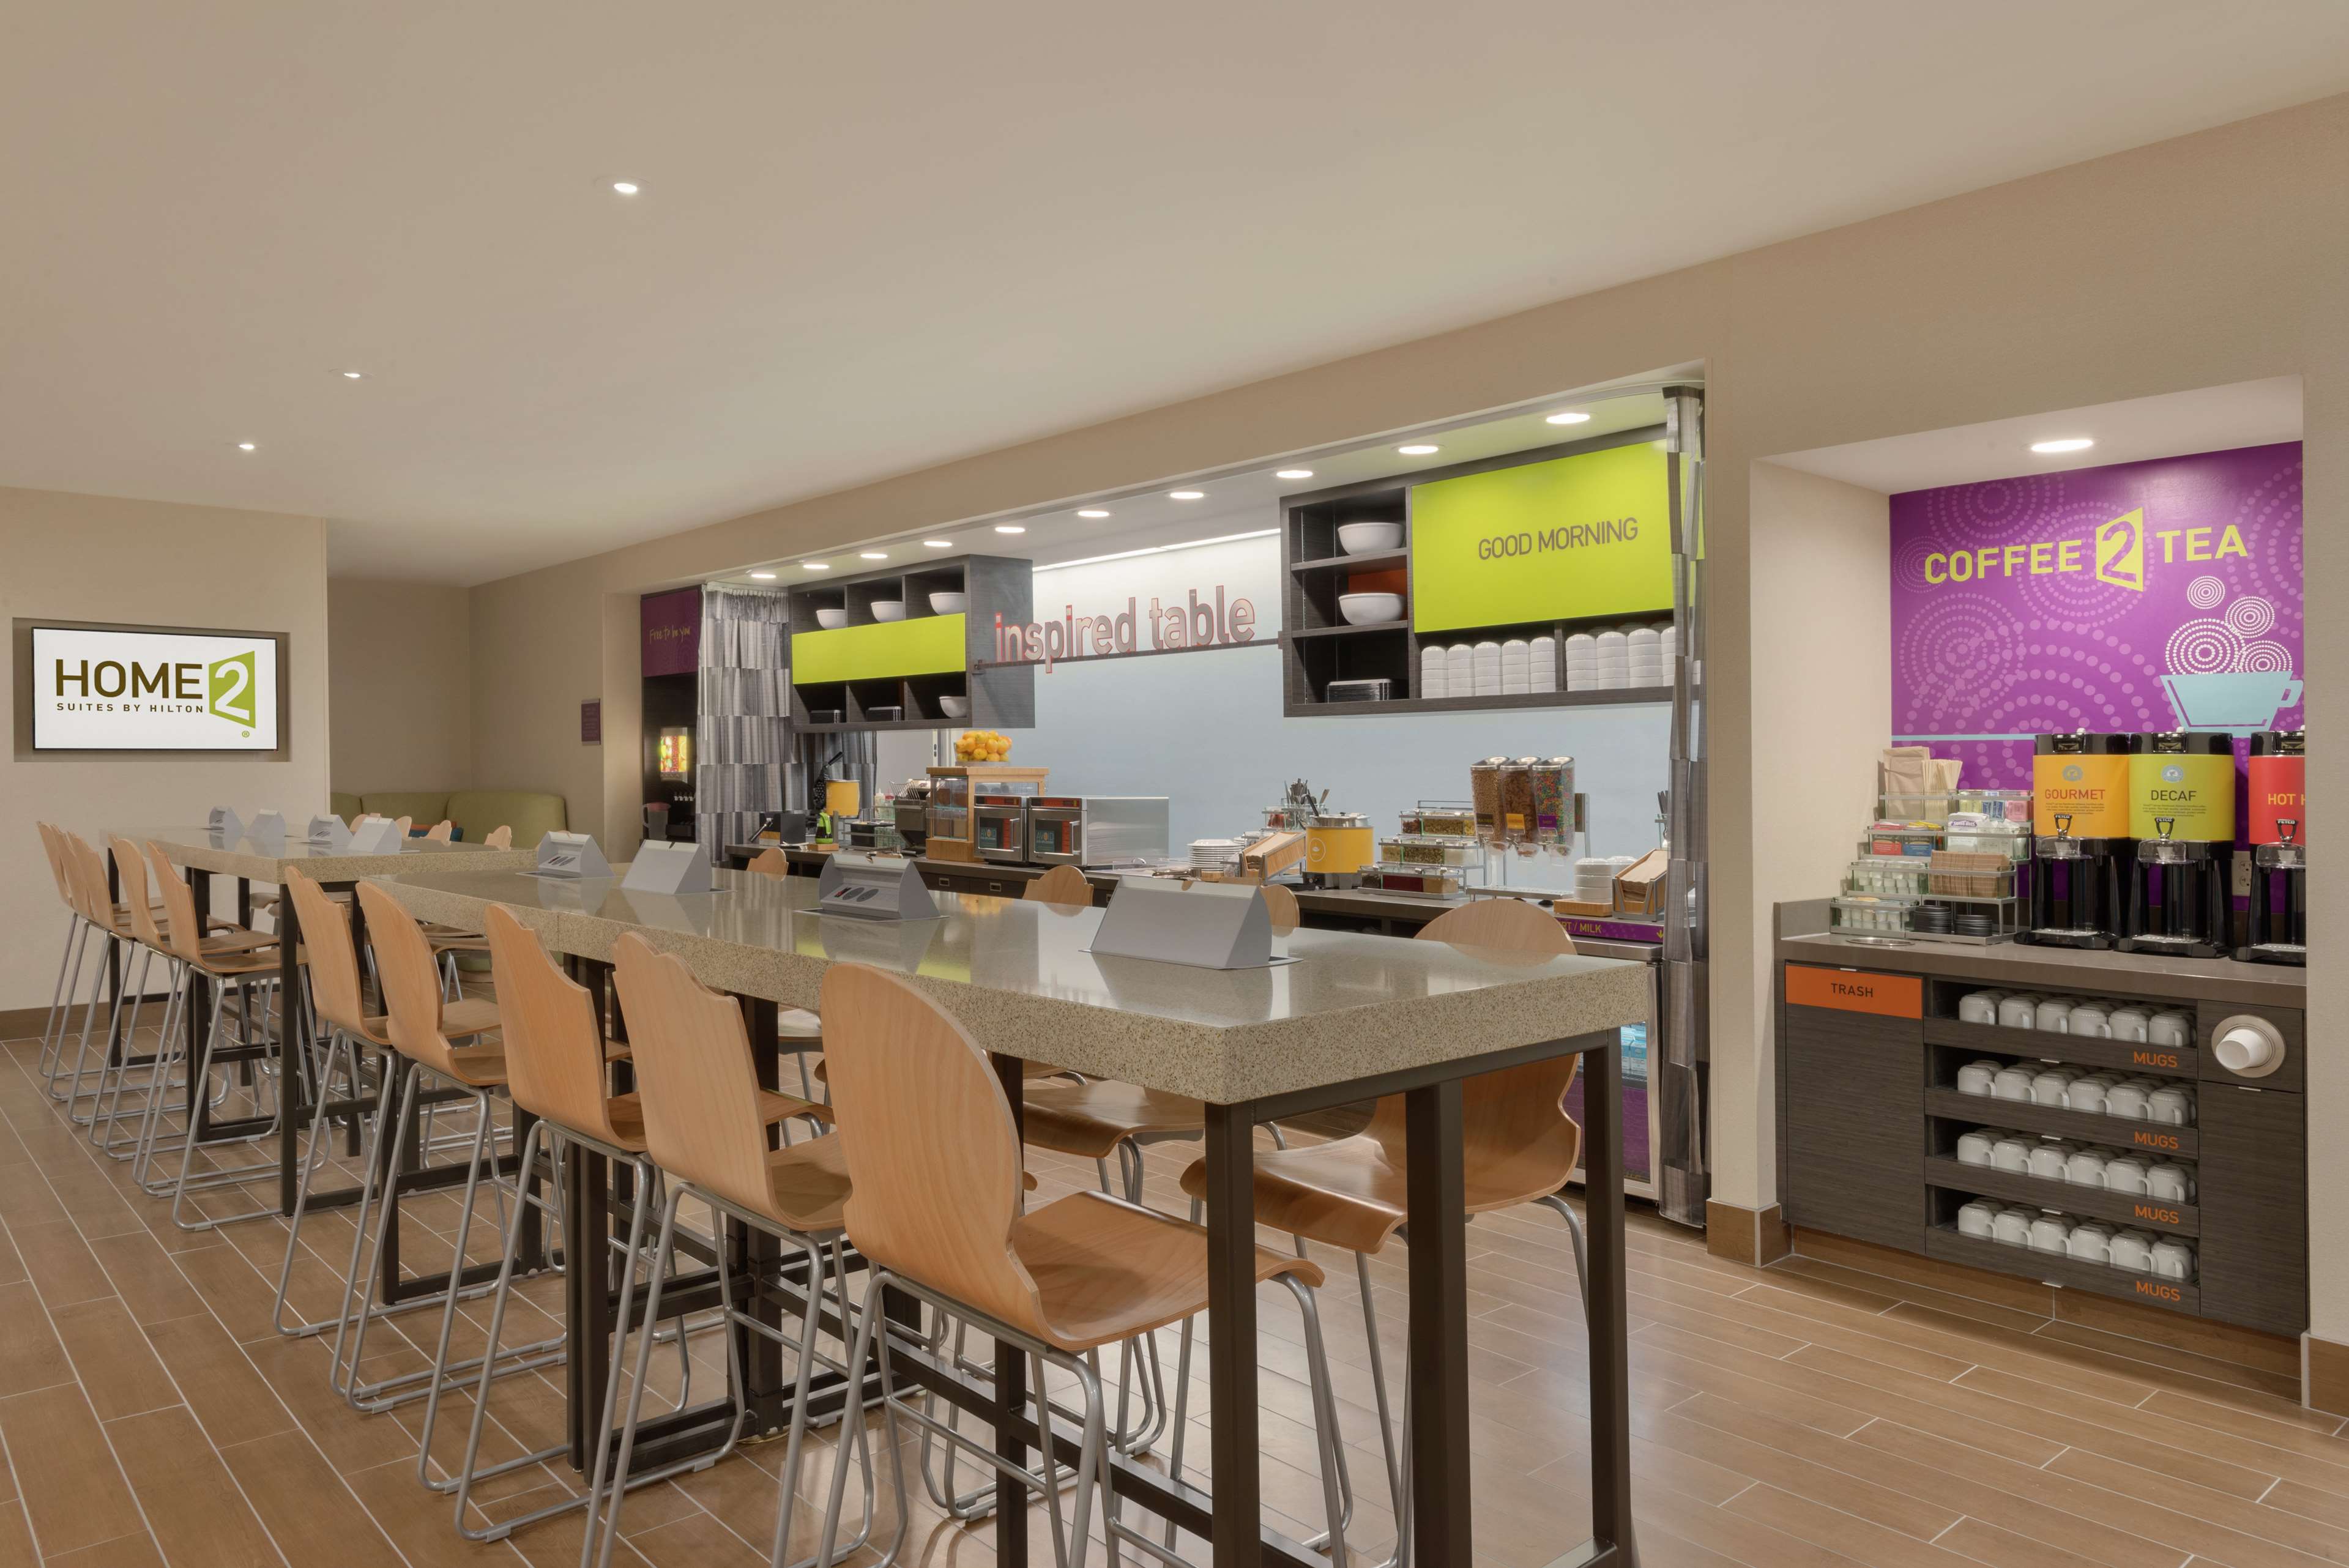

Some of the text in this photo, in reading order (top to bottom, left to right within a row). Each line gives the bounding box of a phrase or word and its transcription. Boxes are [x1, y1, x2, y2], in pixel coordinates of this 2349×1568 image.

[1478, 517, 1639, 560] GOOD MORNING
[1924, 519, 2248, 584] COFFEE 2 TEA
[650, 629, 662, 645] Free
[995, 585, 1255, 674] inspired table
[57, 702, 204, 713] SUITES BY HILTON
[2045, 789, 2105, 800] GOURMET
[2151, 790, 2197, 801] DECAF
[2268, 793, 2296, 805] HOT
[1579, 923, 1601, 934] MILK
[1830, 982, 1874, 998] TRASH
[2133, 1050, 2178, 1068] MUGS
[2134, 1131, 2179, 1150] MUGS
[2135, 1204, 2179, 1224] MUGS
[2136, 1280, 2180, 1302] MUGS
